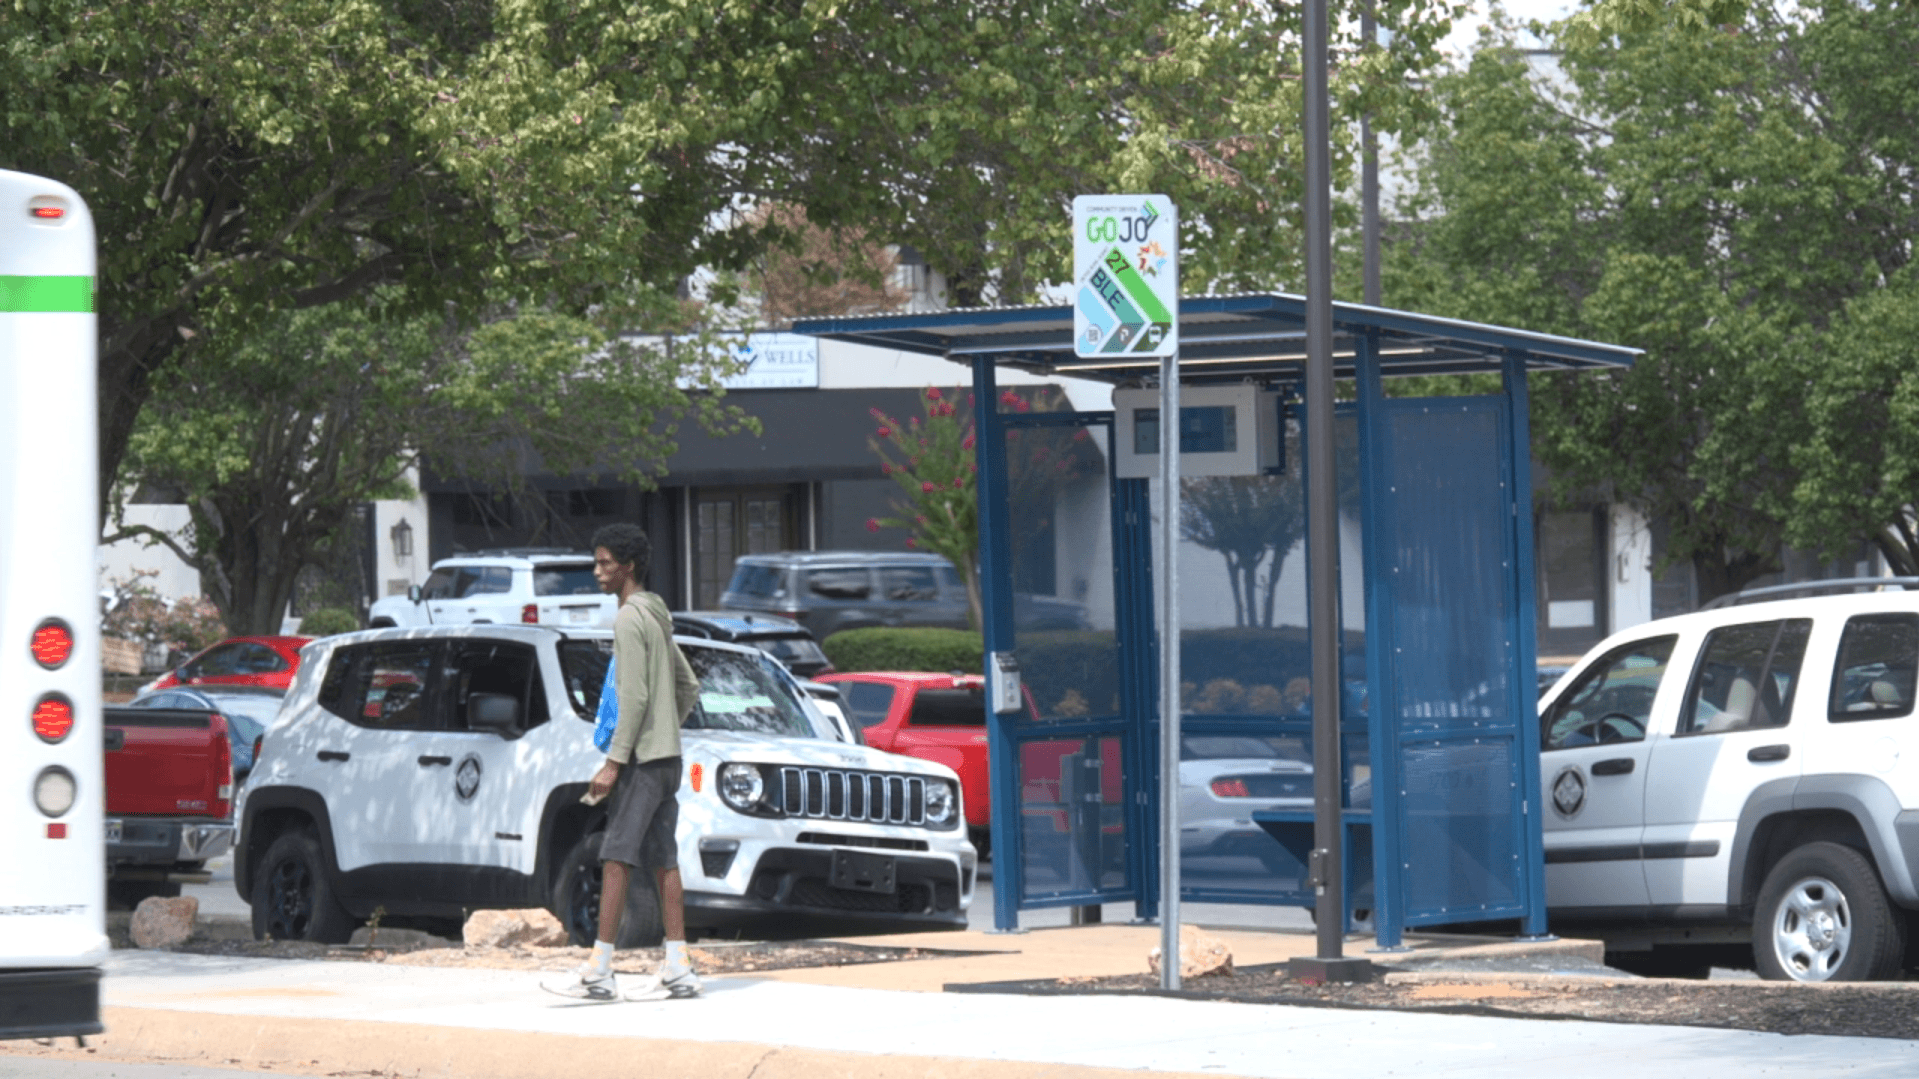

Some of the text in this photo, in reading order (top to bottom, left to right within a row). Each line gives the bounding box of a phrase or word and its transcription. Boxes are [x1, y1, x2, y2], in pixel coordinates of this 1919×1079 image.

[1086, 215, 1149, 243] GOJO
[1105, 250, 1131, 275] 27
[1090, 267, 1125, 312] BLE
[764, 350, 816, 364] WELLS
